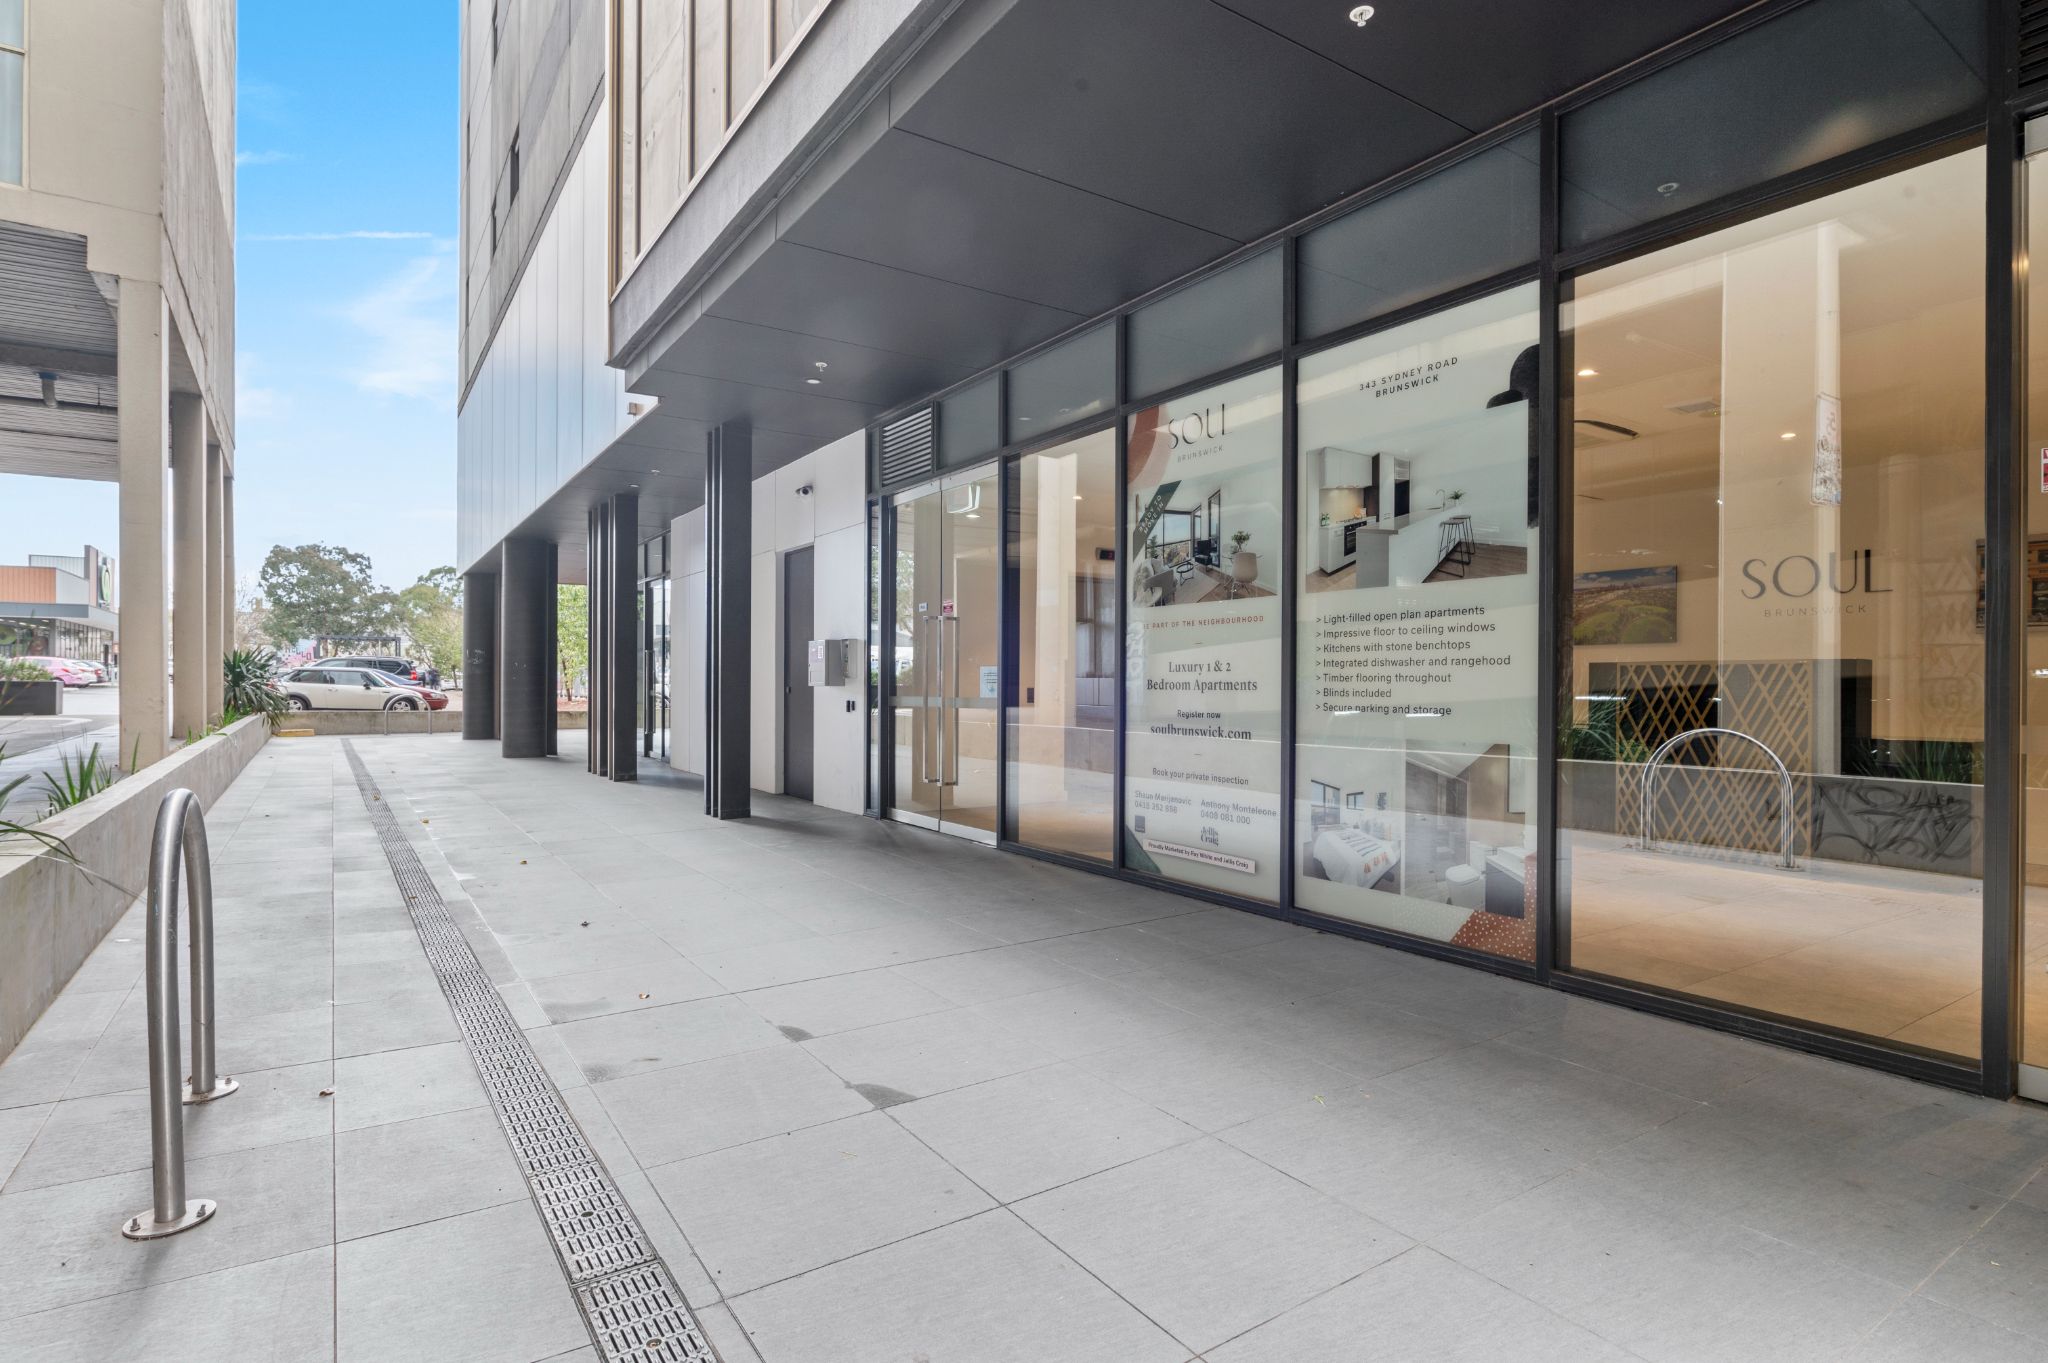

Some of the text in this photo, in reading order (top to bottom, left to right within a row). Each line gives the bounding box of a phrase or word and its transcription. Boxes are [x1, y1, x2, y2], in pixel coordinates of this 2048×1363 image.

[1359, 357, 1458, 391] 343 SYDNEY ROAD
[1375, 374, 1439, 398] BRUNSWICK
[1168, 403, 1232, 449] SOUL
[1177, 445, 1223, 462] BRUNSWICK
[1740, 549, 1893, 600] SOUL
[1323, 606, 1485, 625] Light-filled open plan apartments
[1764, 604, 1867, 618] BRUNSWICK
[1198, 615, 1264, 626] NEIGHBOURHOOD
[1323, 622, 1496, 639] Impressive floor to ceiling windows
[1323, 640, 1471, 653] Kitchens with stone benchtops
[1168, 660, 1231, 675] Luxury 1 & 2
[1323, 655, 1511, 669] Integrated dishwasher and rangehood
[1323, 673, 1452, 684] Timber flooring throughout
[1147, 679, 1258, 693] Bedroom Apartments
[1323, 688, 1391, 698] Blinds included
[1177, 709, 1221, 719] Register now
[1323, 702, 1452, 716] Secure parking and storage
[1150, 723, 1252, 740] soulbrunswick.com
[1152, 768, 1249, 786] Book your private inspection
[1232, 803, 1277, 817] Monteleone
